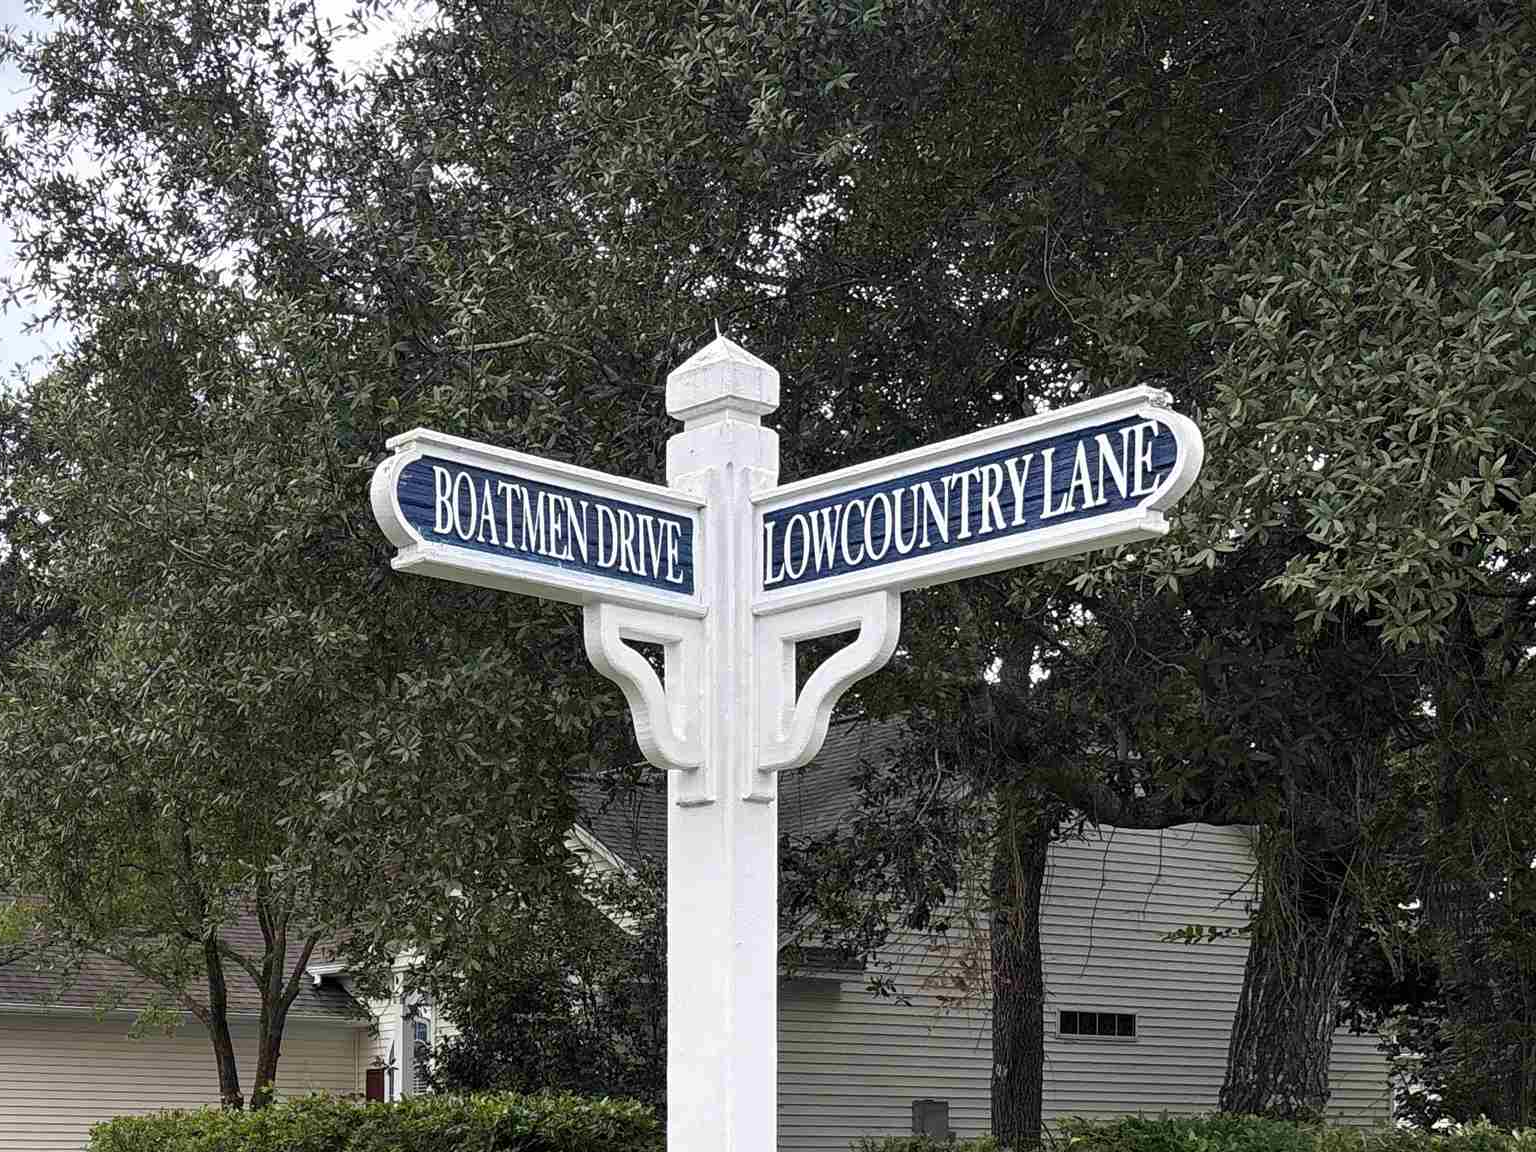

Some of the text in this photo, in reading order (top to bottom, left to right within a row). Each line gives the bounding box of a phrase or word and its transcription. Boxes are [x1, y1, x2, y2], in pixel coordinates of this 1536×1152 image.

[432, 465, 685, 584] BOATMEN DRIVE
[763, 419, 1163, 586] LOWCOUNTRY LANE
